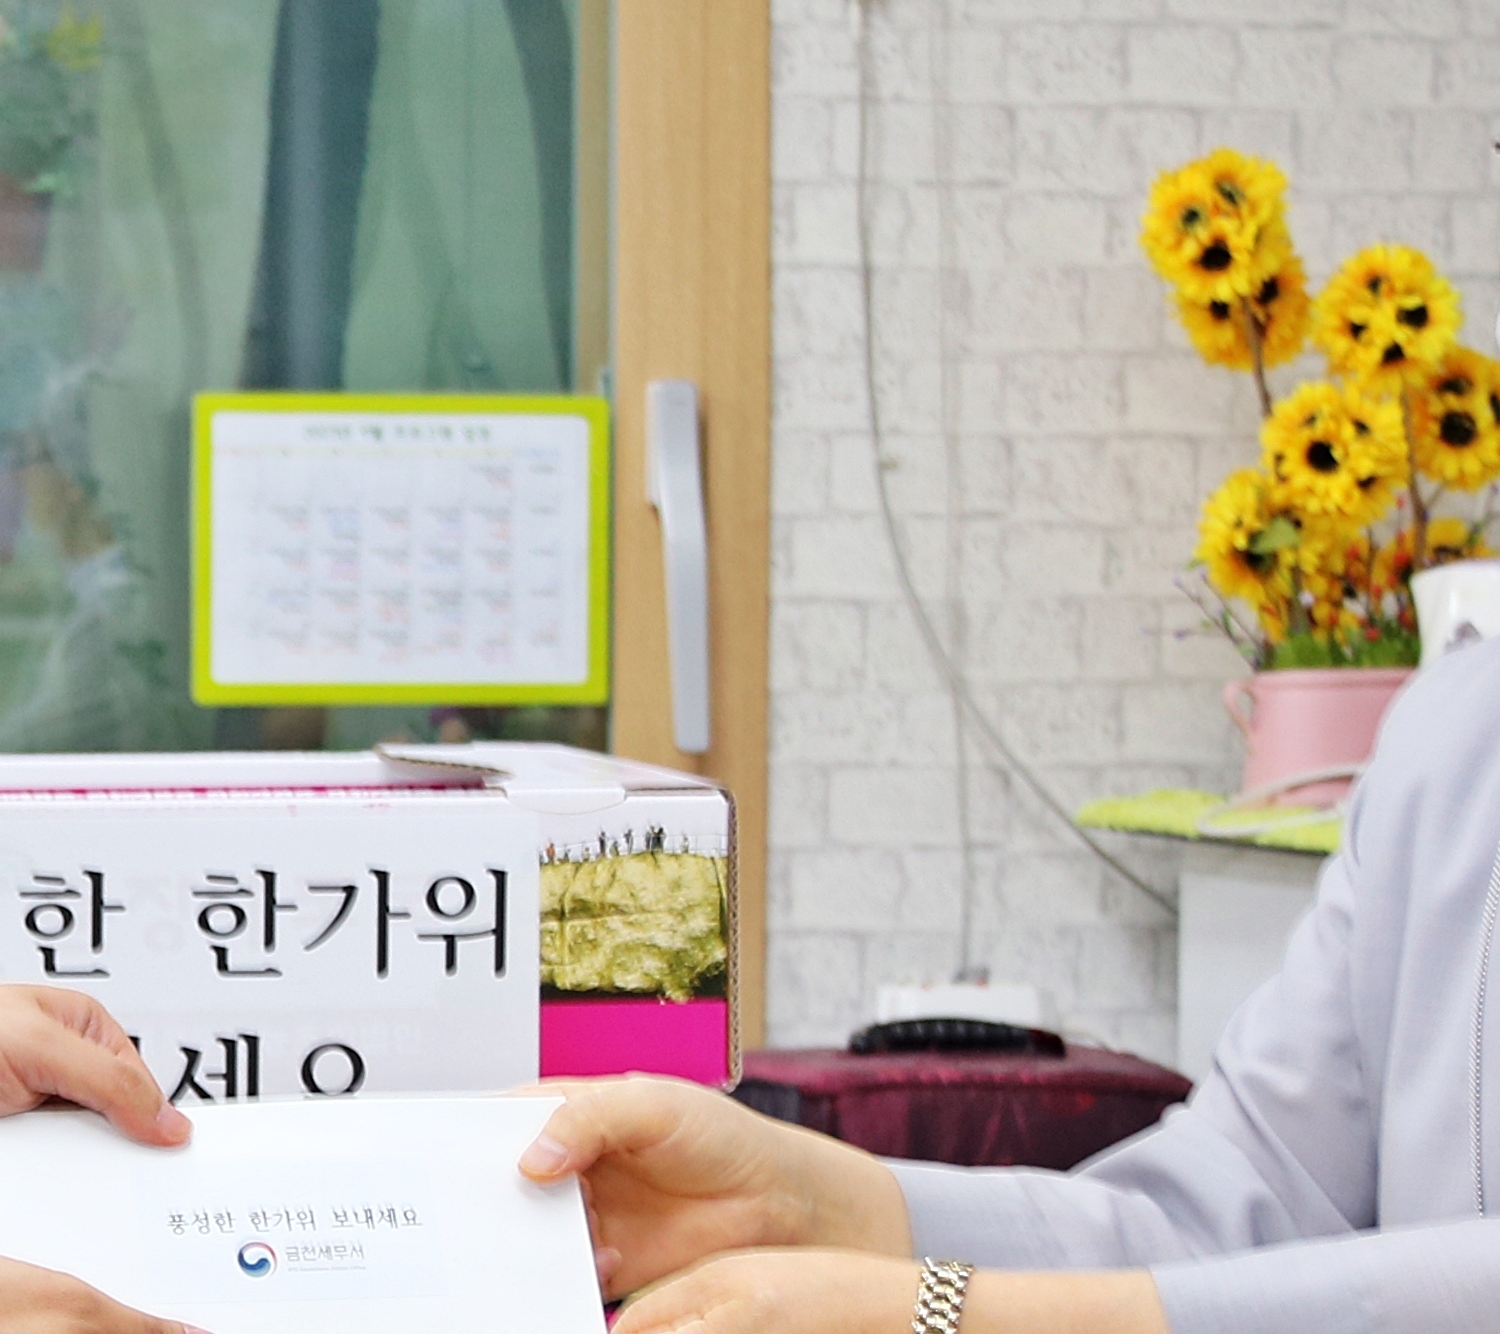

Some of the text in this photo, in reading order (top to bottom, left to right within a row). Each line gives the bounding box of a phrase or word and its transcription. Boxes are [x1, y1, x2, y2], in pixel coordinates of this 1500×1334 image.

[192, 868, 509, 979] 한가위
[129, 1033, 366, 1102] 세요
[166, 1205, 423, 1236] 풍성한 한가위 보내세요
[285, 1242, 366, 1262] 금천세무서
